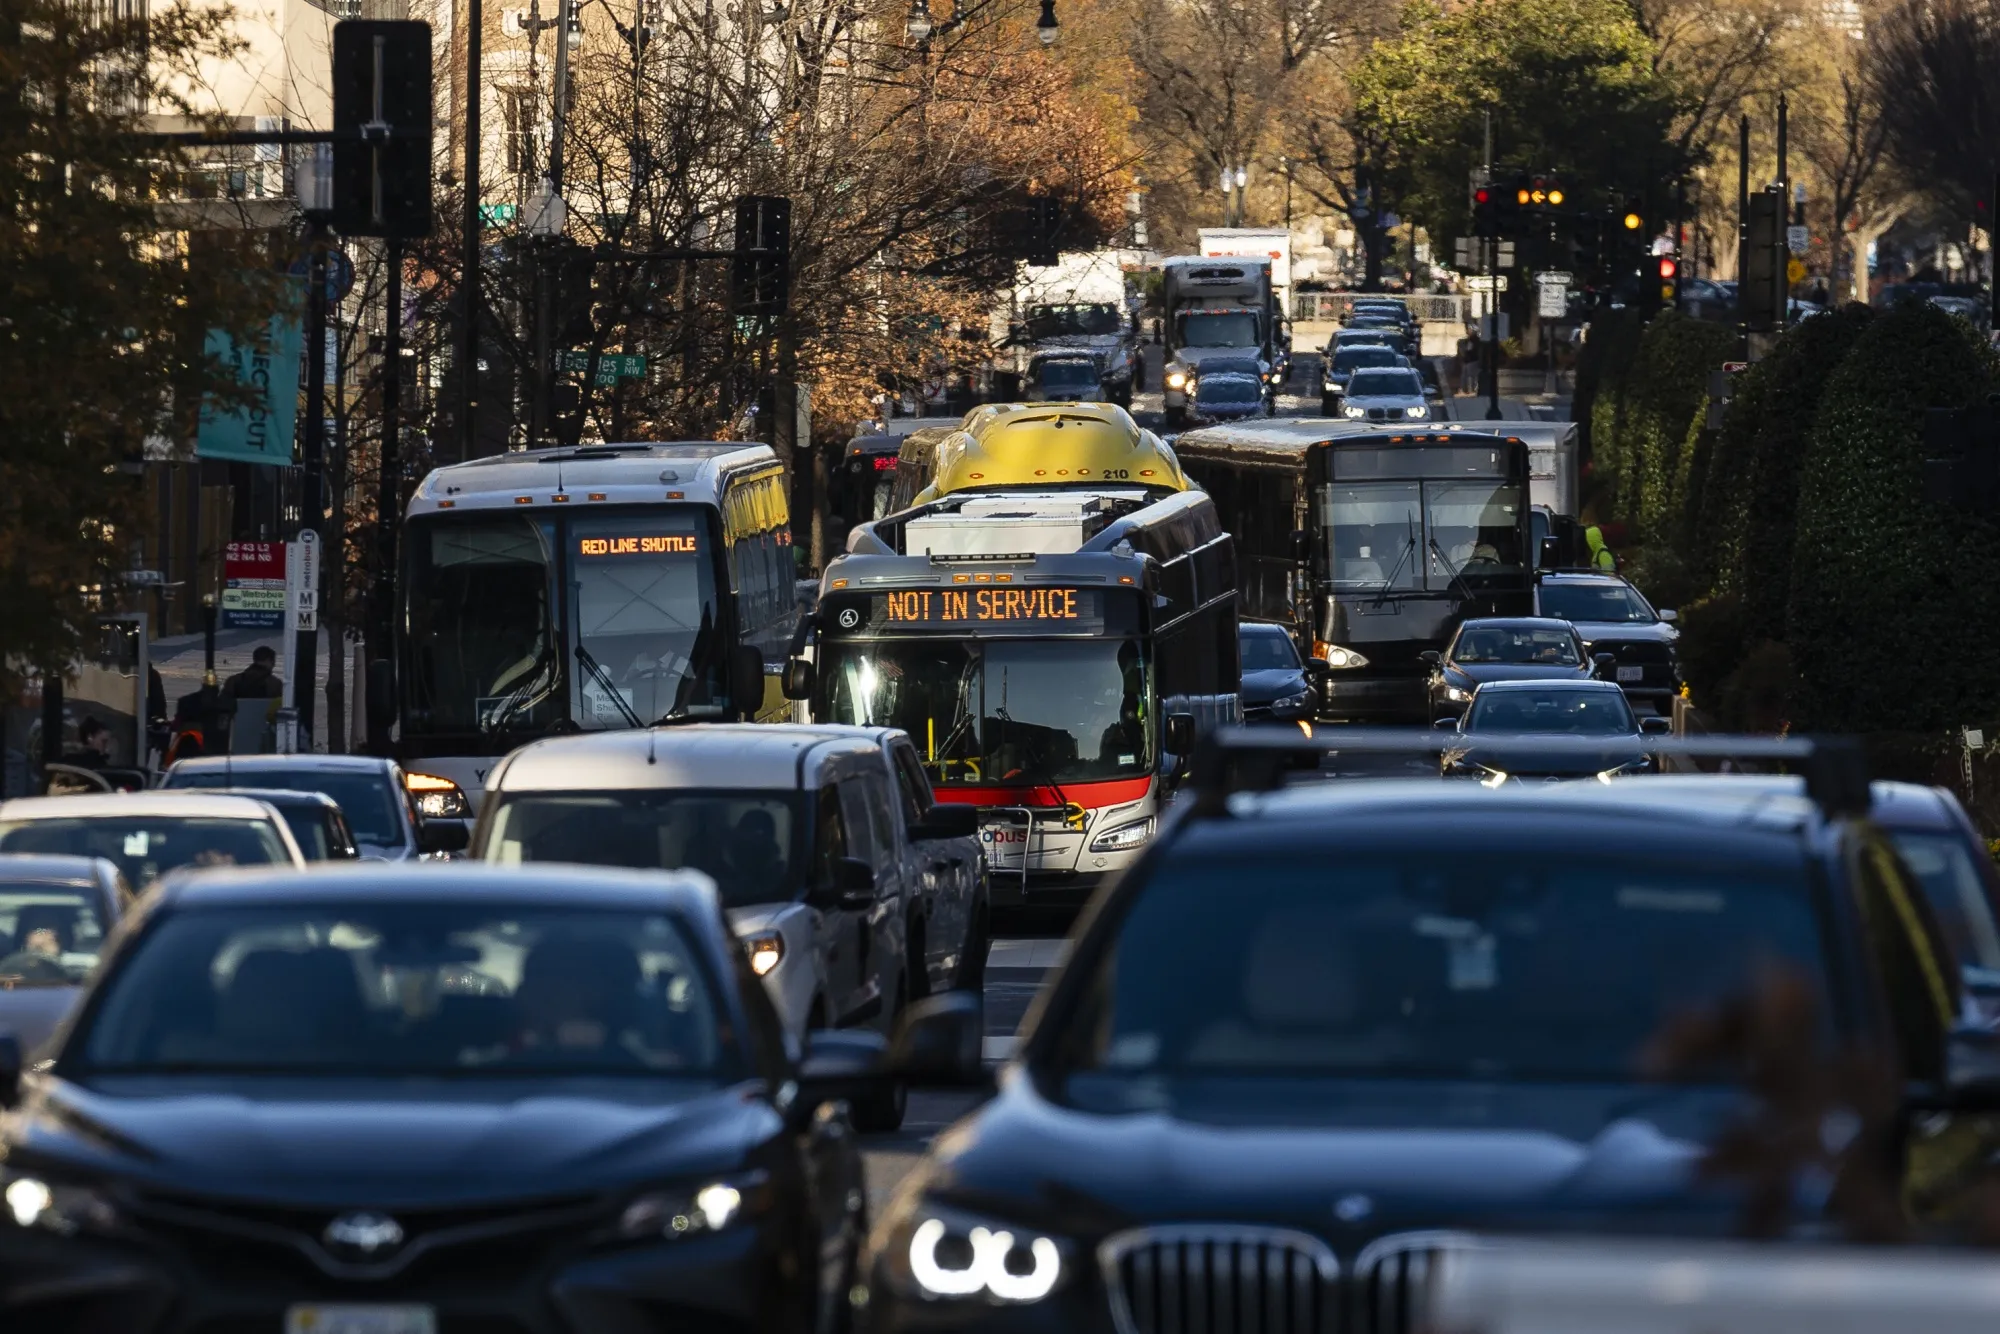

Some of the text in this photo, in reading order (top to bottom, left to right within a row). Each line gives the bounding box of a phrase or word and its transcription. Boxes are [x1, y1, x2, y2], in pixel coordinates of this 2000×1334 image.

[626, 358, 635, 366] St
[624, 366, 640, 375] NW
[1103, 469, 1129, 479] 210
[581, 536, 696, 554] RED LINE SHUTTLE
[300, 592, 313, 605] M
[242, 600, 285, 609] SHUTTLE
[888, 589, 1077, 621] NOT IN SERVICE
[298, 612, 312, 625] M
